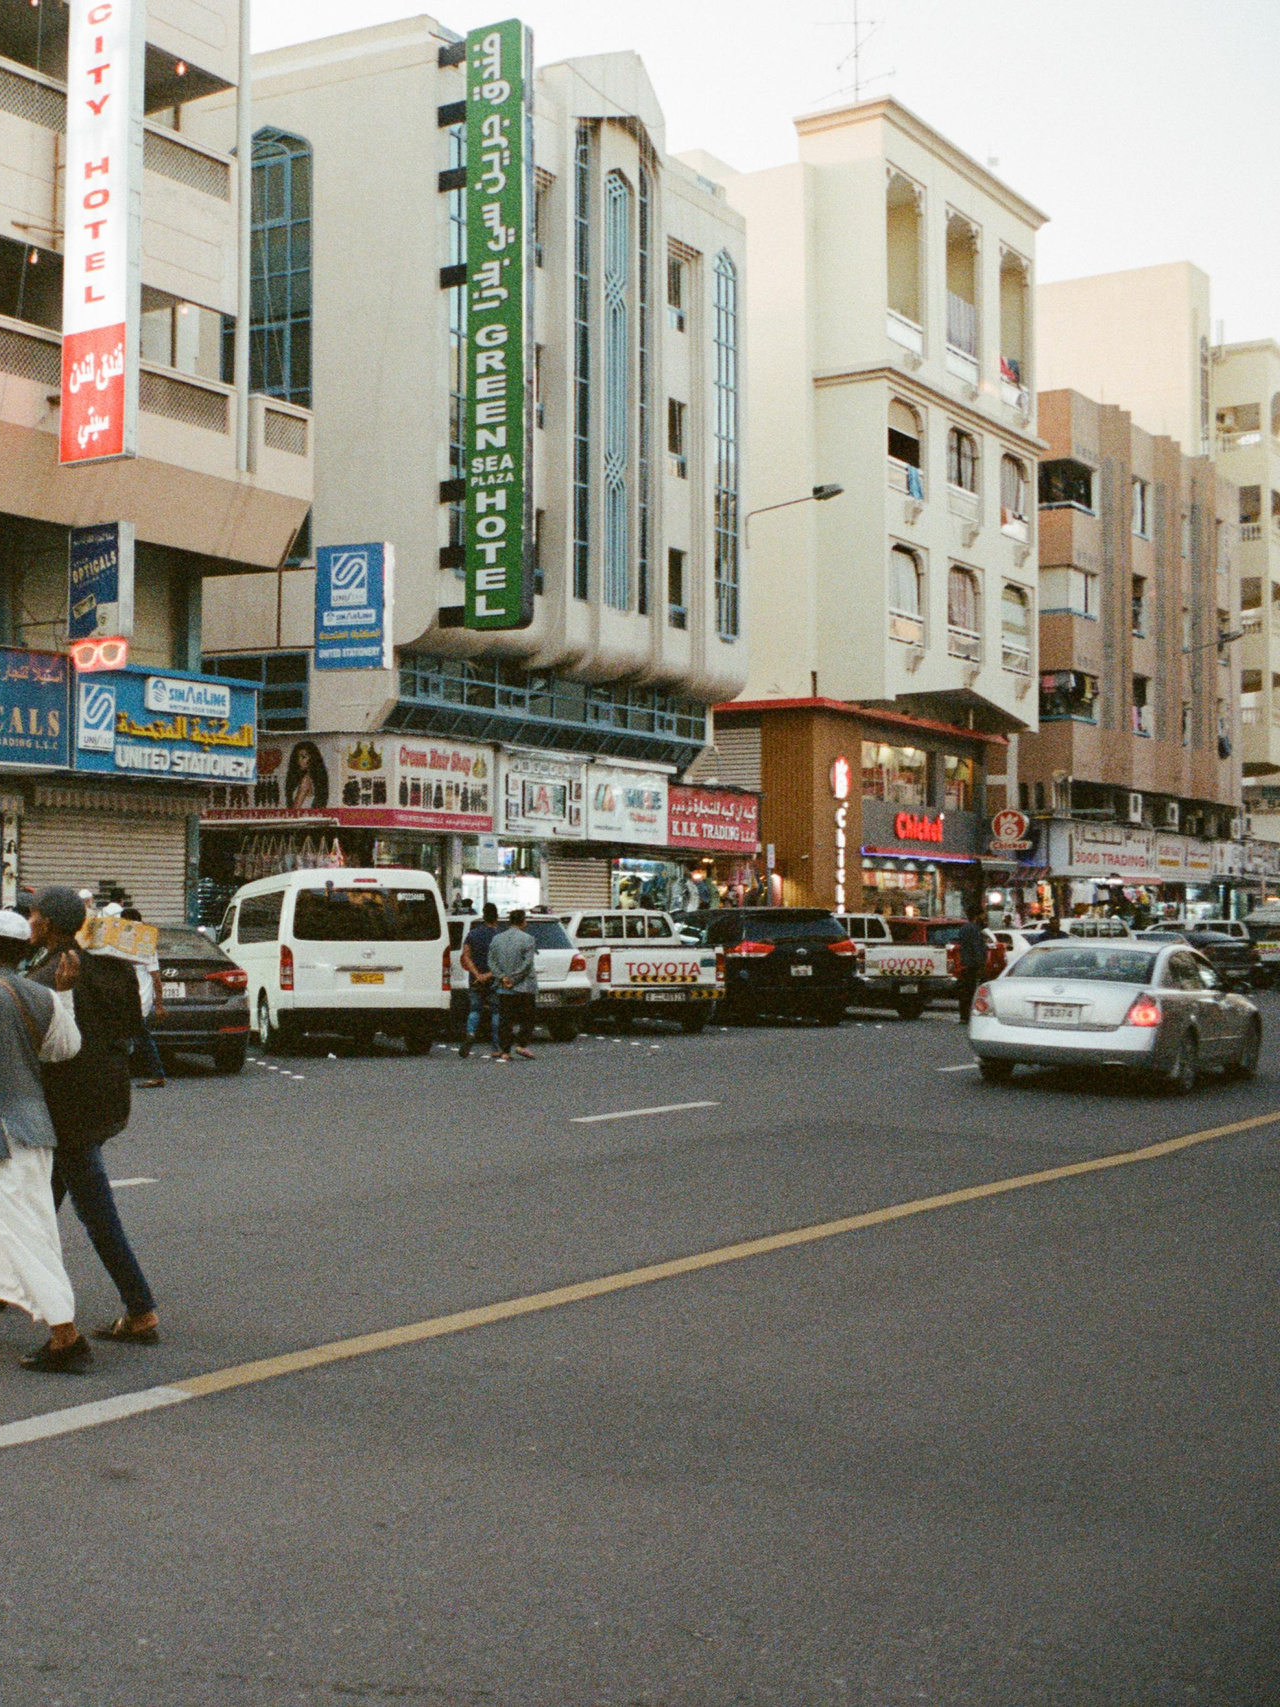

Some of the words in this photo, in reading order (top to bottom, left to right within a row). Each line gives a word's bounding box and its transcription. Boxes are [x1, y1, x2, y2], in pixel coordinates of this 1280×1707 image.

[85, 3, 113, 116] CITY
[472, 31, 511, 105] فندق
[474, 113, 511, 195] جرين
[82, 156, 110, 304] HOTEL
[481, 202, 515, 252] سي
[472, 258, 510, 312] بلازا
[475, 324, 508, 451] GREEN
[470, 472, 515, 487] PLAZA
[471, 453, 514, 475] SEA
[72, 550, 117, 584] OPTICALS
[475, 489, 506, 618] HOTEL
[116, 711, 188, 740] المتحدة
[190, 718, 254, 753] المكتبة
[115, 744, 170, 772] UNITED
[171, 750, 256, 780] STATIONERY
[701, 823, 740, 840] TRADING
[1101, 852, 1146, 868] TRADING
[625, 961, 702, 977] TOYOTA
[877, 957, 935, 970] TOYOTA
